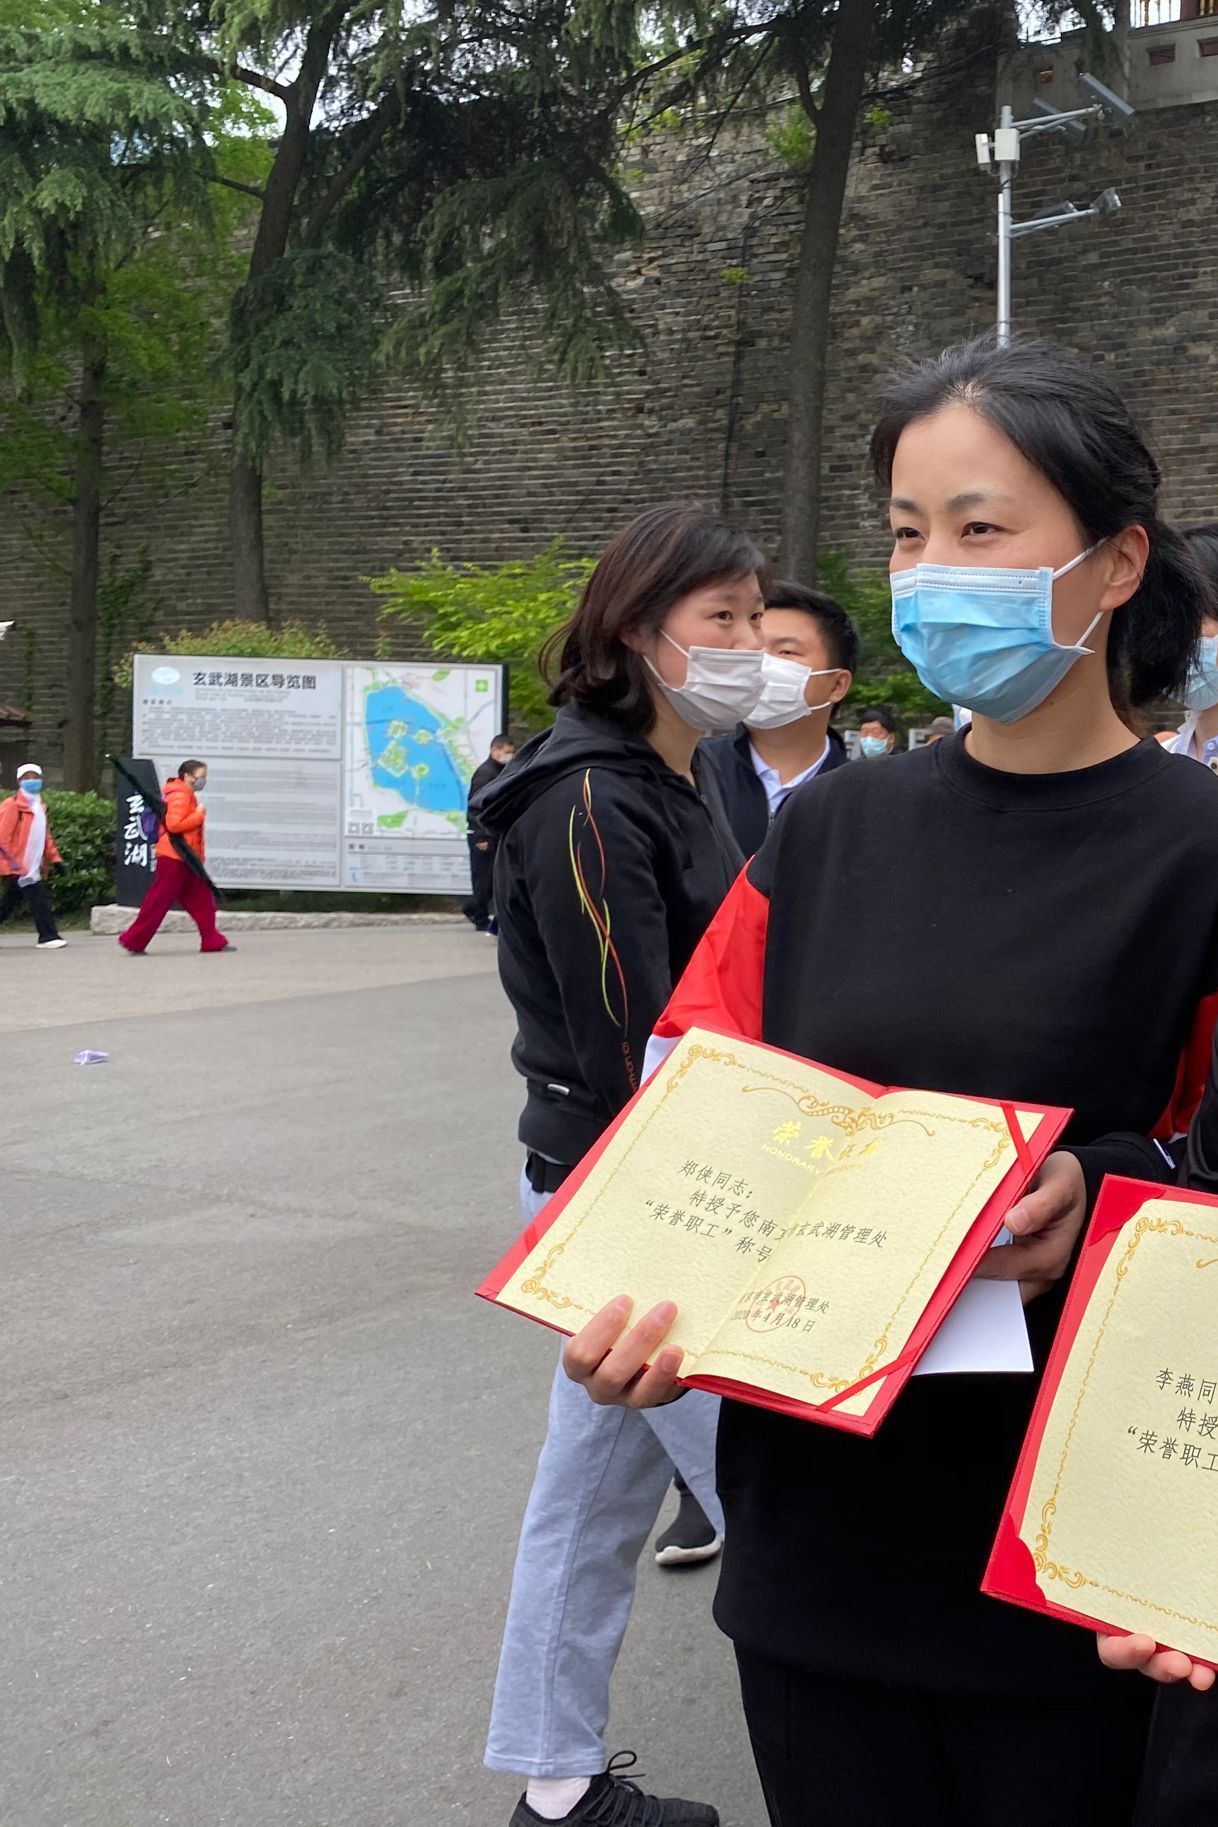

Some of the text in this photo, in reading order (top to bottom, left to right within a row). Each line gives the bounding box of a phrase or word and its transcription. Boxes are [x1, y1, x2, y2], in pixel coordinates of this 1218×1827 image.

[192, 671, 317, 691] 玄武湖景区导览图
[123, 791, 148, 868] 玄武湖
[772, 1119, 885, 1161] 荣誉
[760, 1143, 823, 1176] HONORARY
